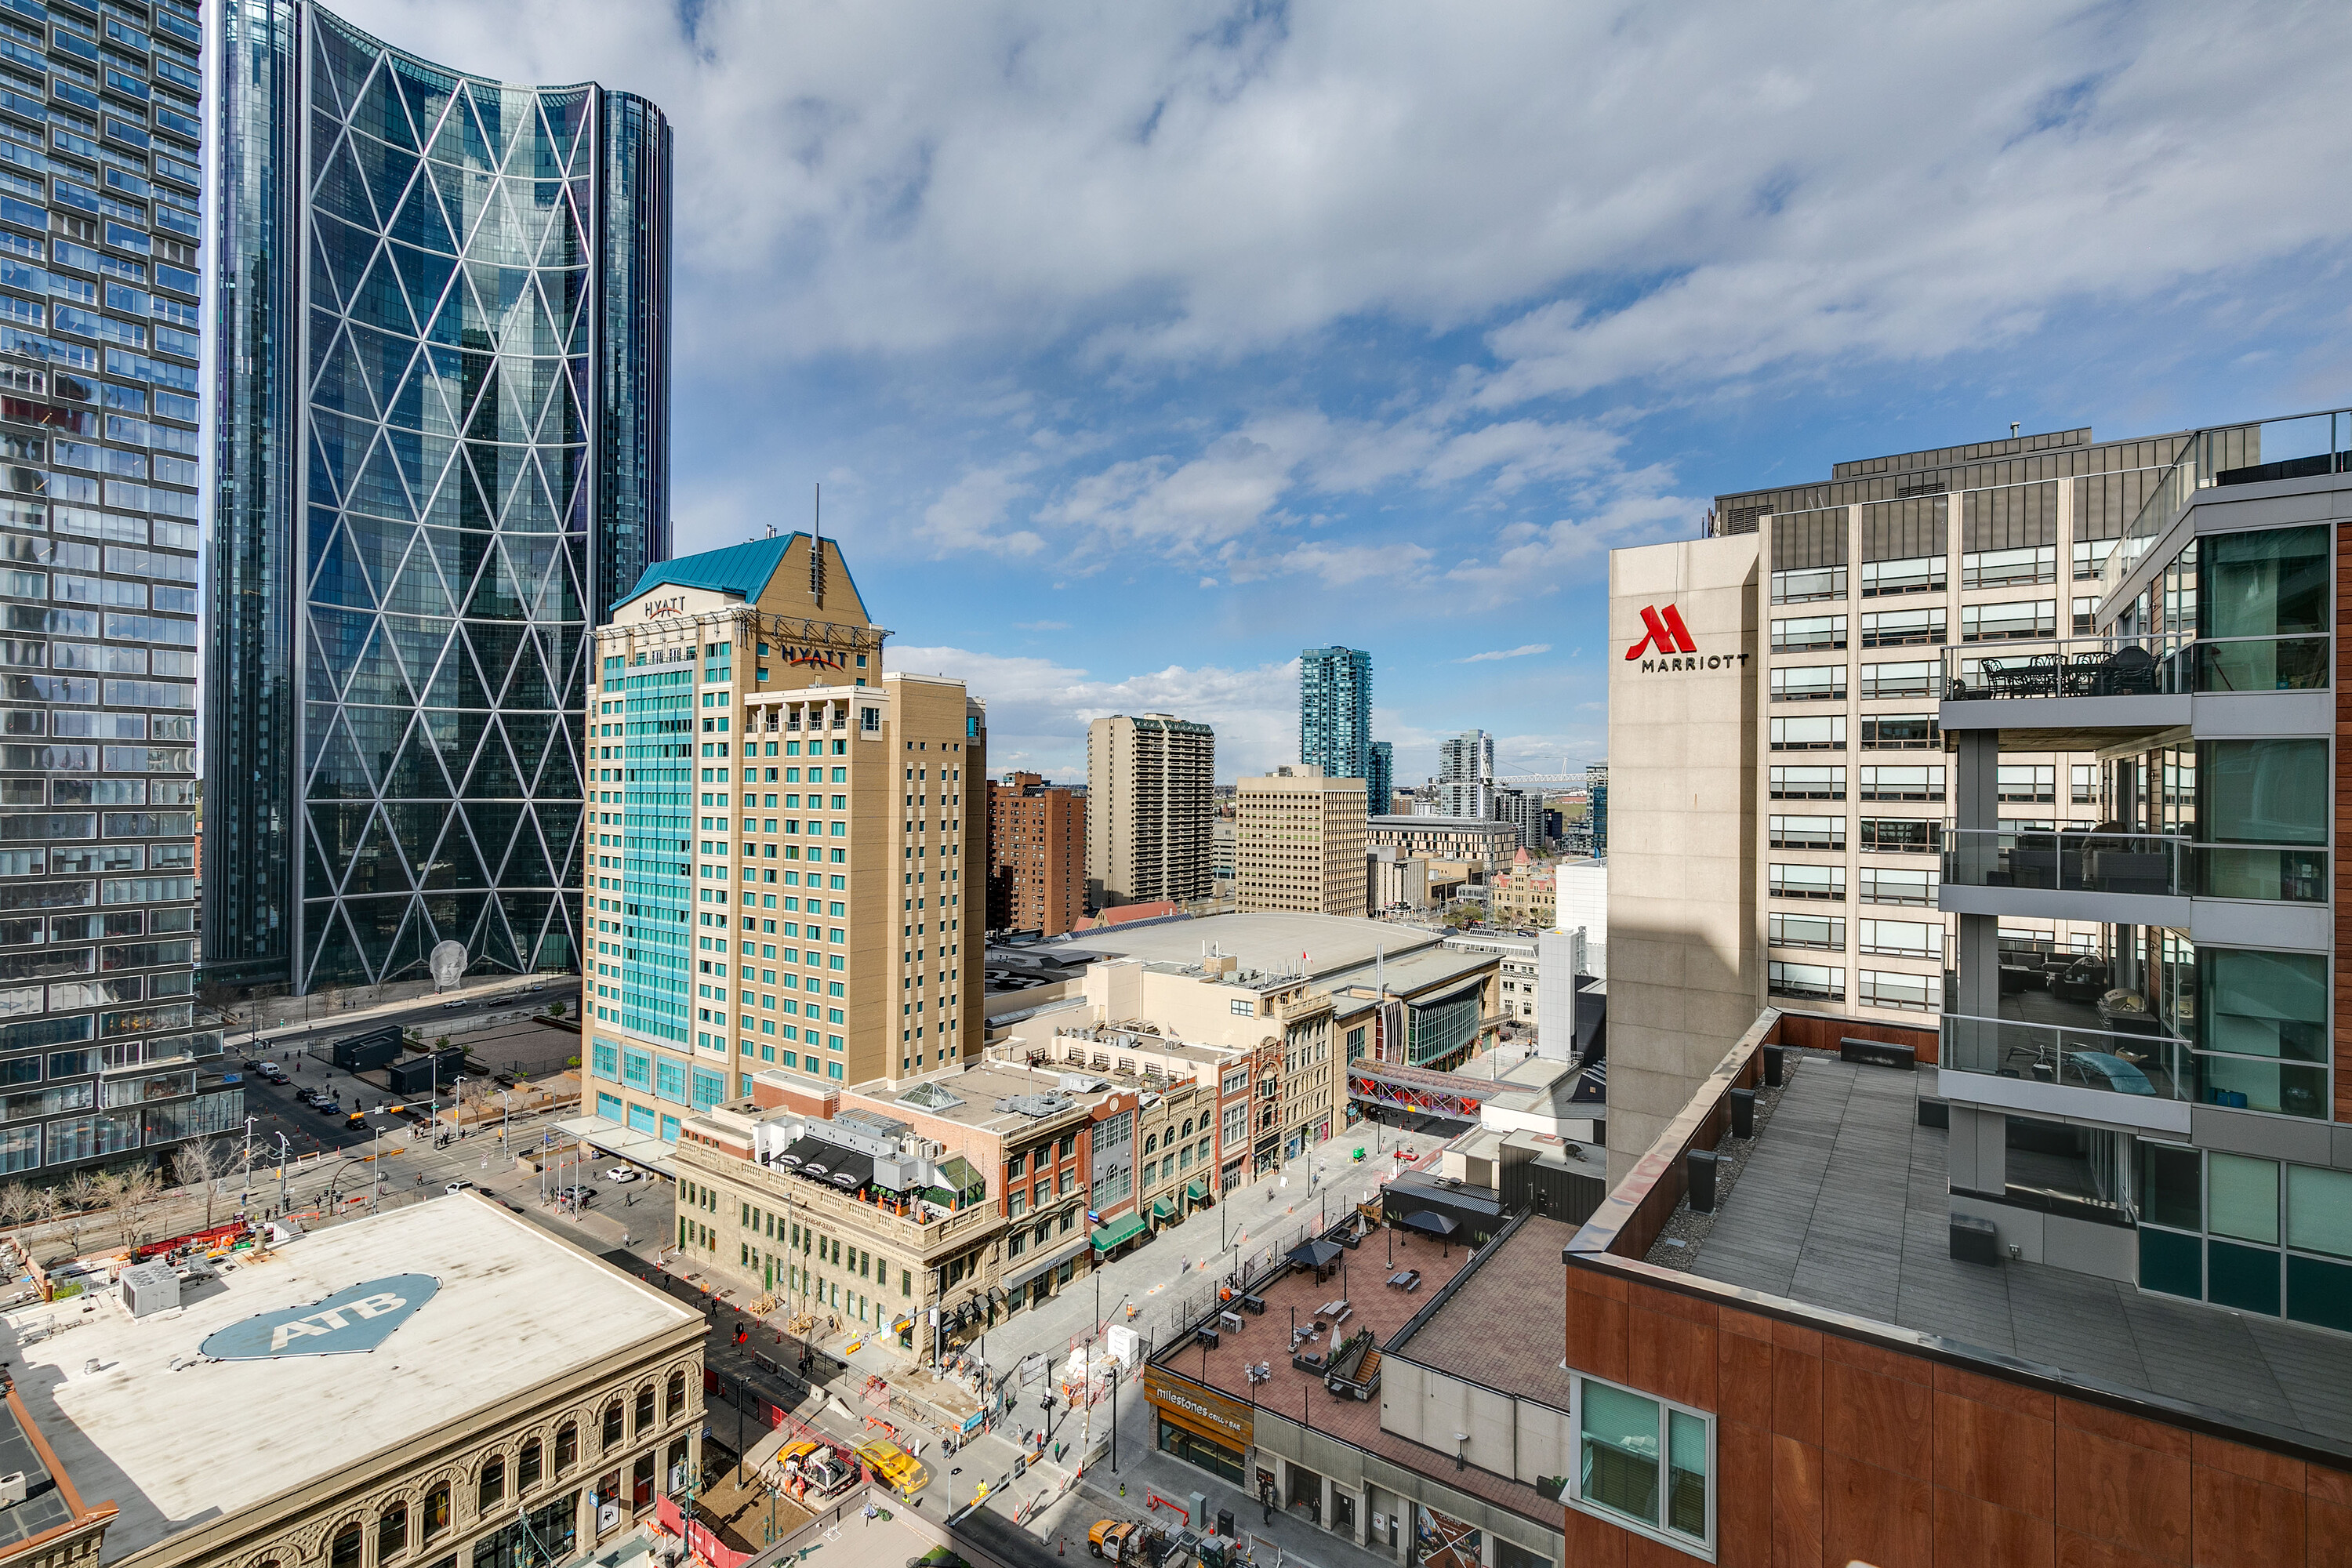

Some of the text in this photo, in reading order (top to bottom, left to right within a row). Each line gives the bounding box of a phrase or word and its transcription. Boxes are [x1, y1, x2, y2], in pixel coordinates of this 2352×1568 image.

[644, 596, 685, 618] HYATT
[782, 644, 847, 670] HYATT
[1642, 653, 1749, 673] MARRIOTT
[270, 1292, 407, 1352] ATB
[1156, 1388, 1241, 1432] milestones GRILL BAR
